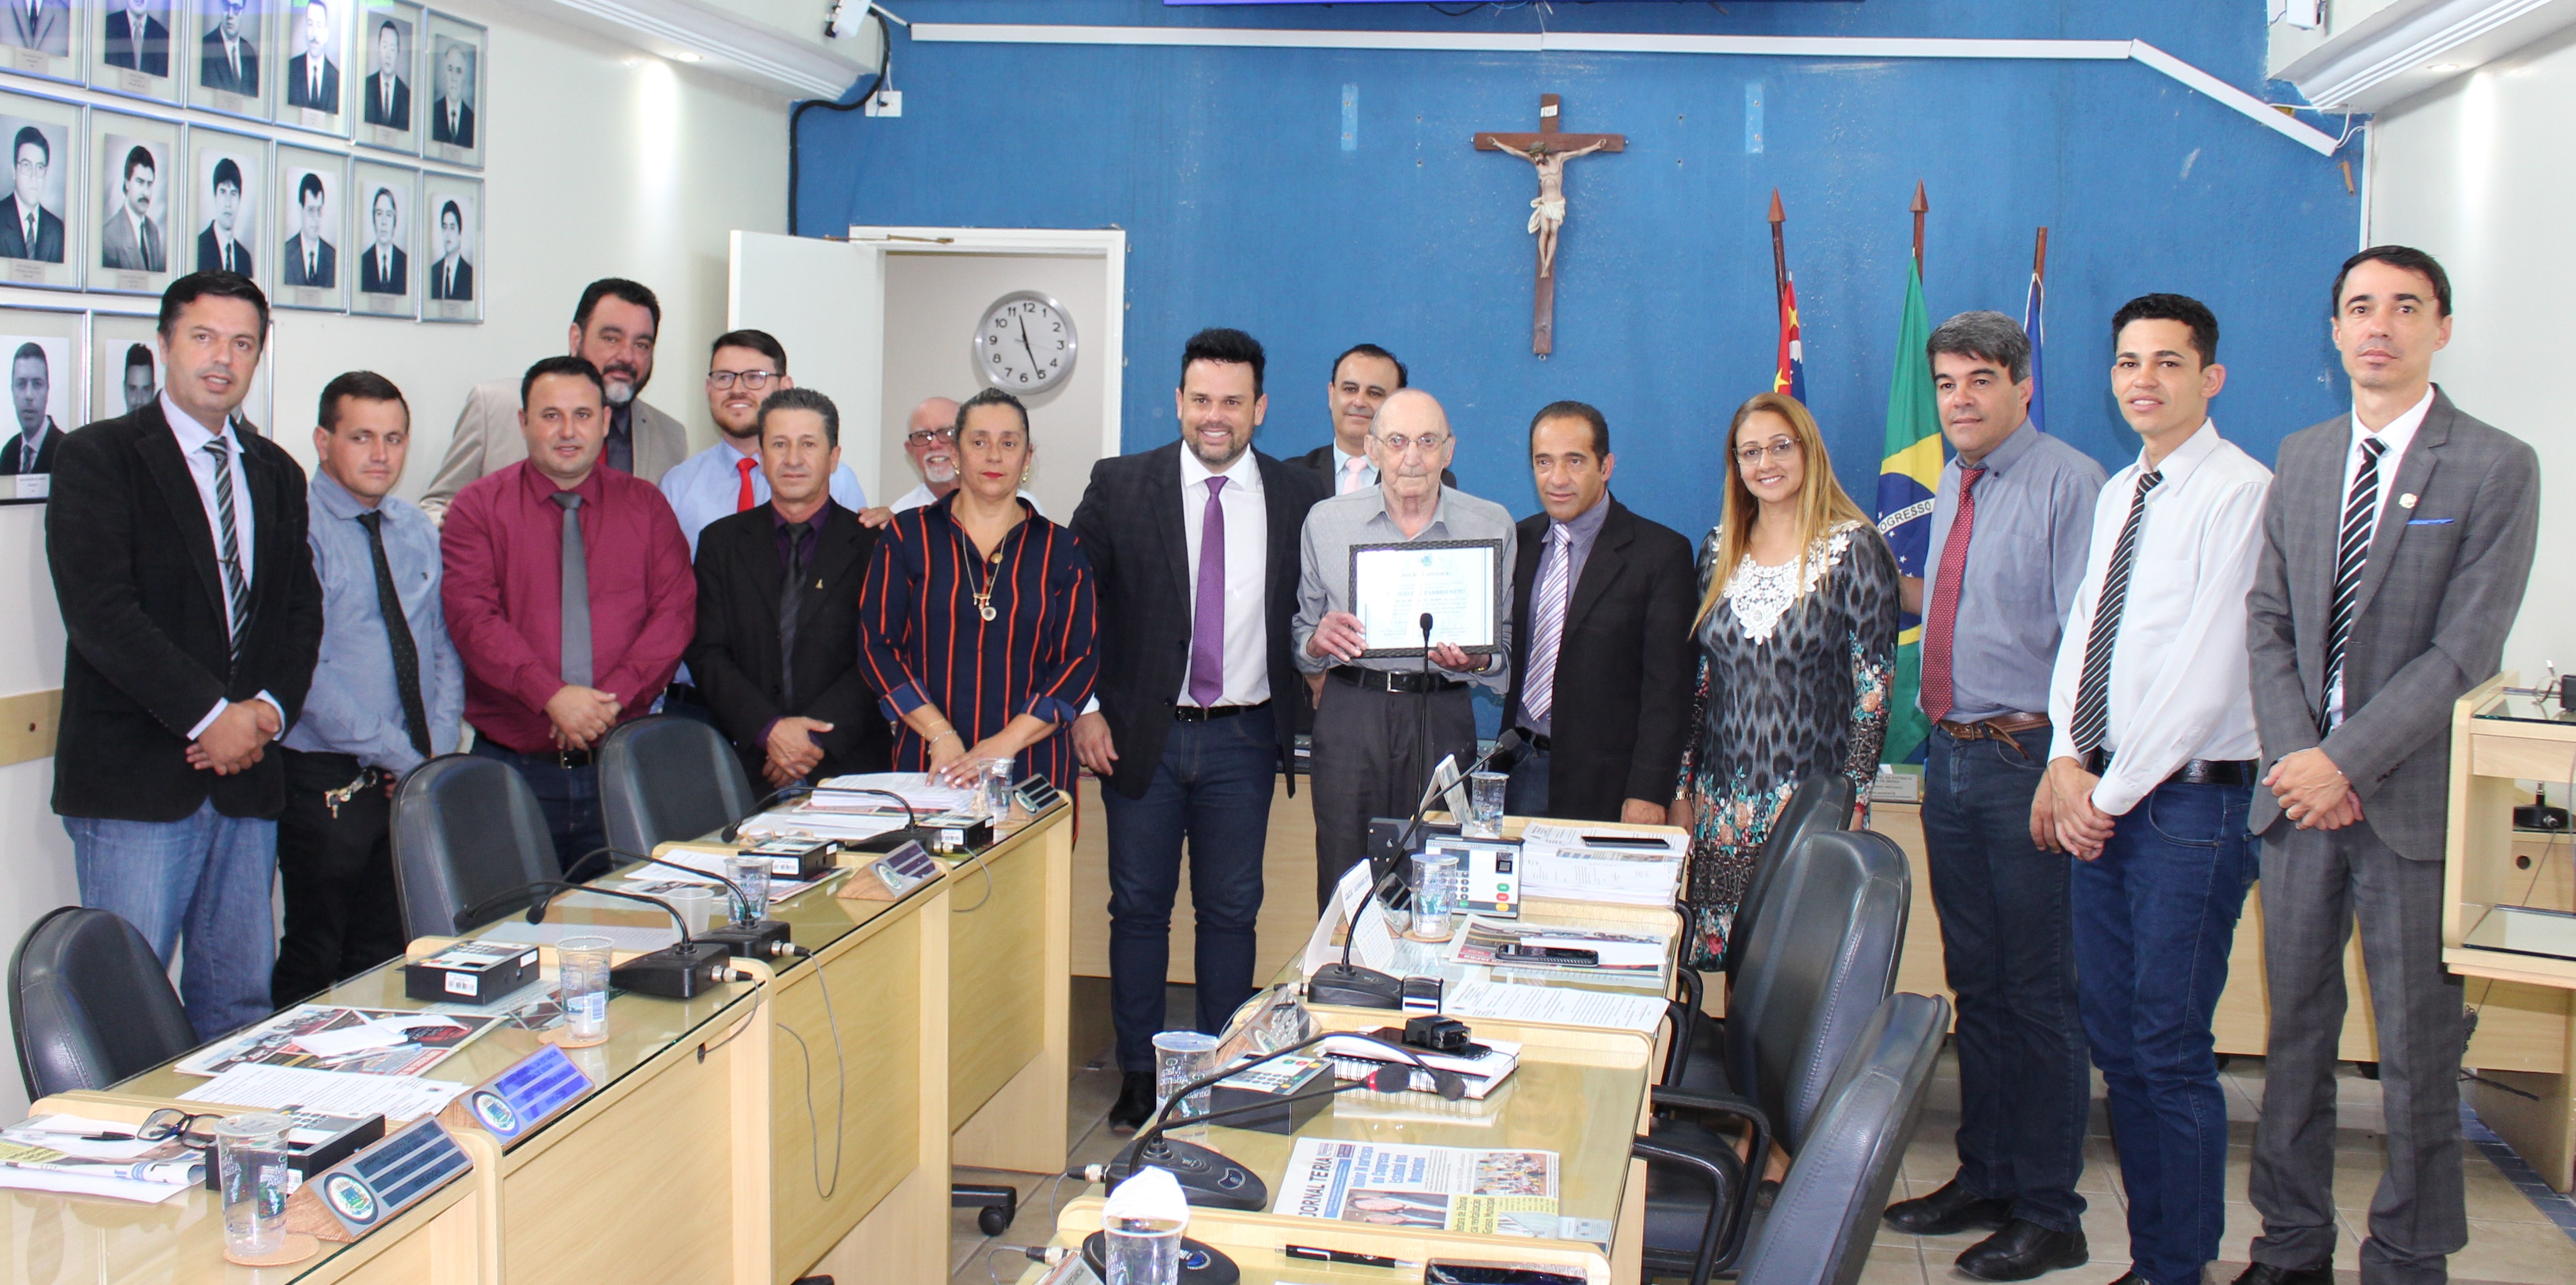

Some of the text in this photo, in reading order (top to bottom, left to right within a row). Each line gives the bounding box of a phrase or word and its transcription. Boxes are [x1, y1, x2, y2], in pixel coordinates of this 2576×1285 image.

[1008, 307, 1017, 317] 11
[1023, 303, 1035, 312] 12
[1042, 308, 1046, 318] 1
[995, 319, 1007, 328] 10
[1052, 323, 1060, 332] 2
[989, 336, 997, 345] 9
[1057, 340, 1064, 350] 3
[992, 354, 1001, 363] 8
[1050, 359, 1057, 367] 4
[1004, 367, 1012, 377] 7
[1038, 370, 1046, 379] 5
[1020, 374, 1028, 382] 6
[1879, 501, 1931, 531] OGRESSO
[1298, 1185, 1325, 1217] JORNAL
